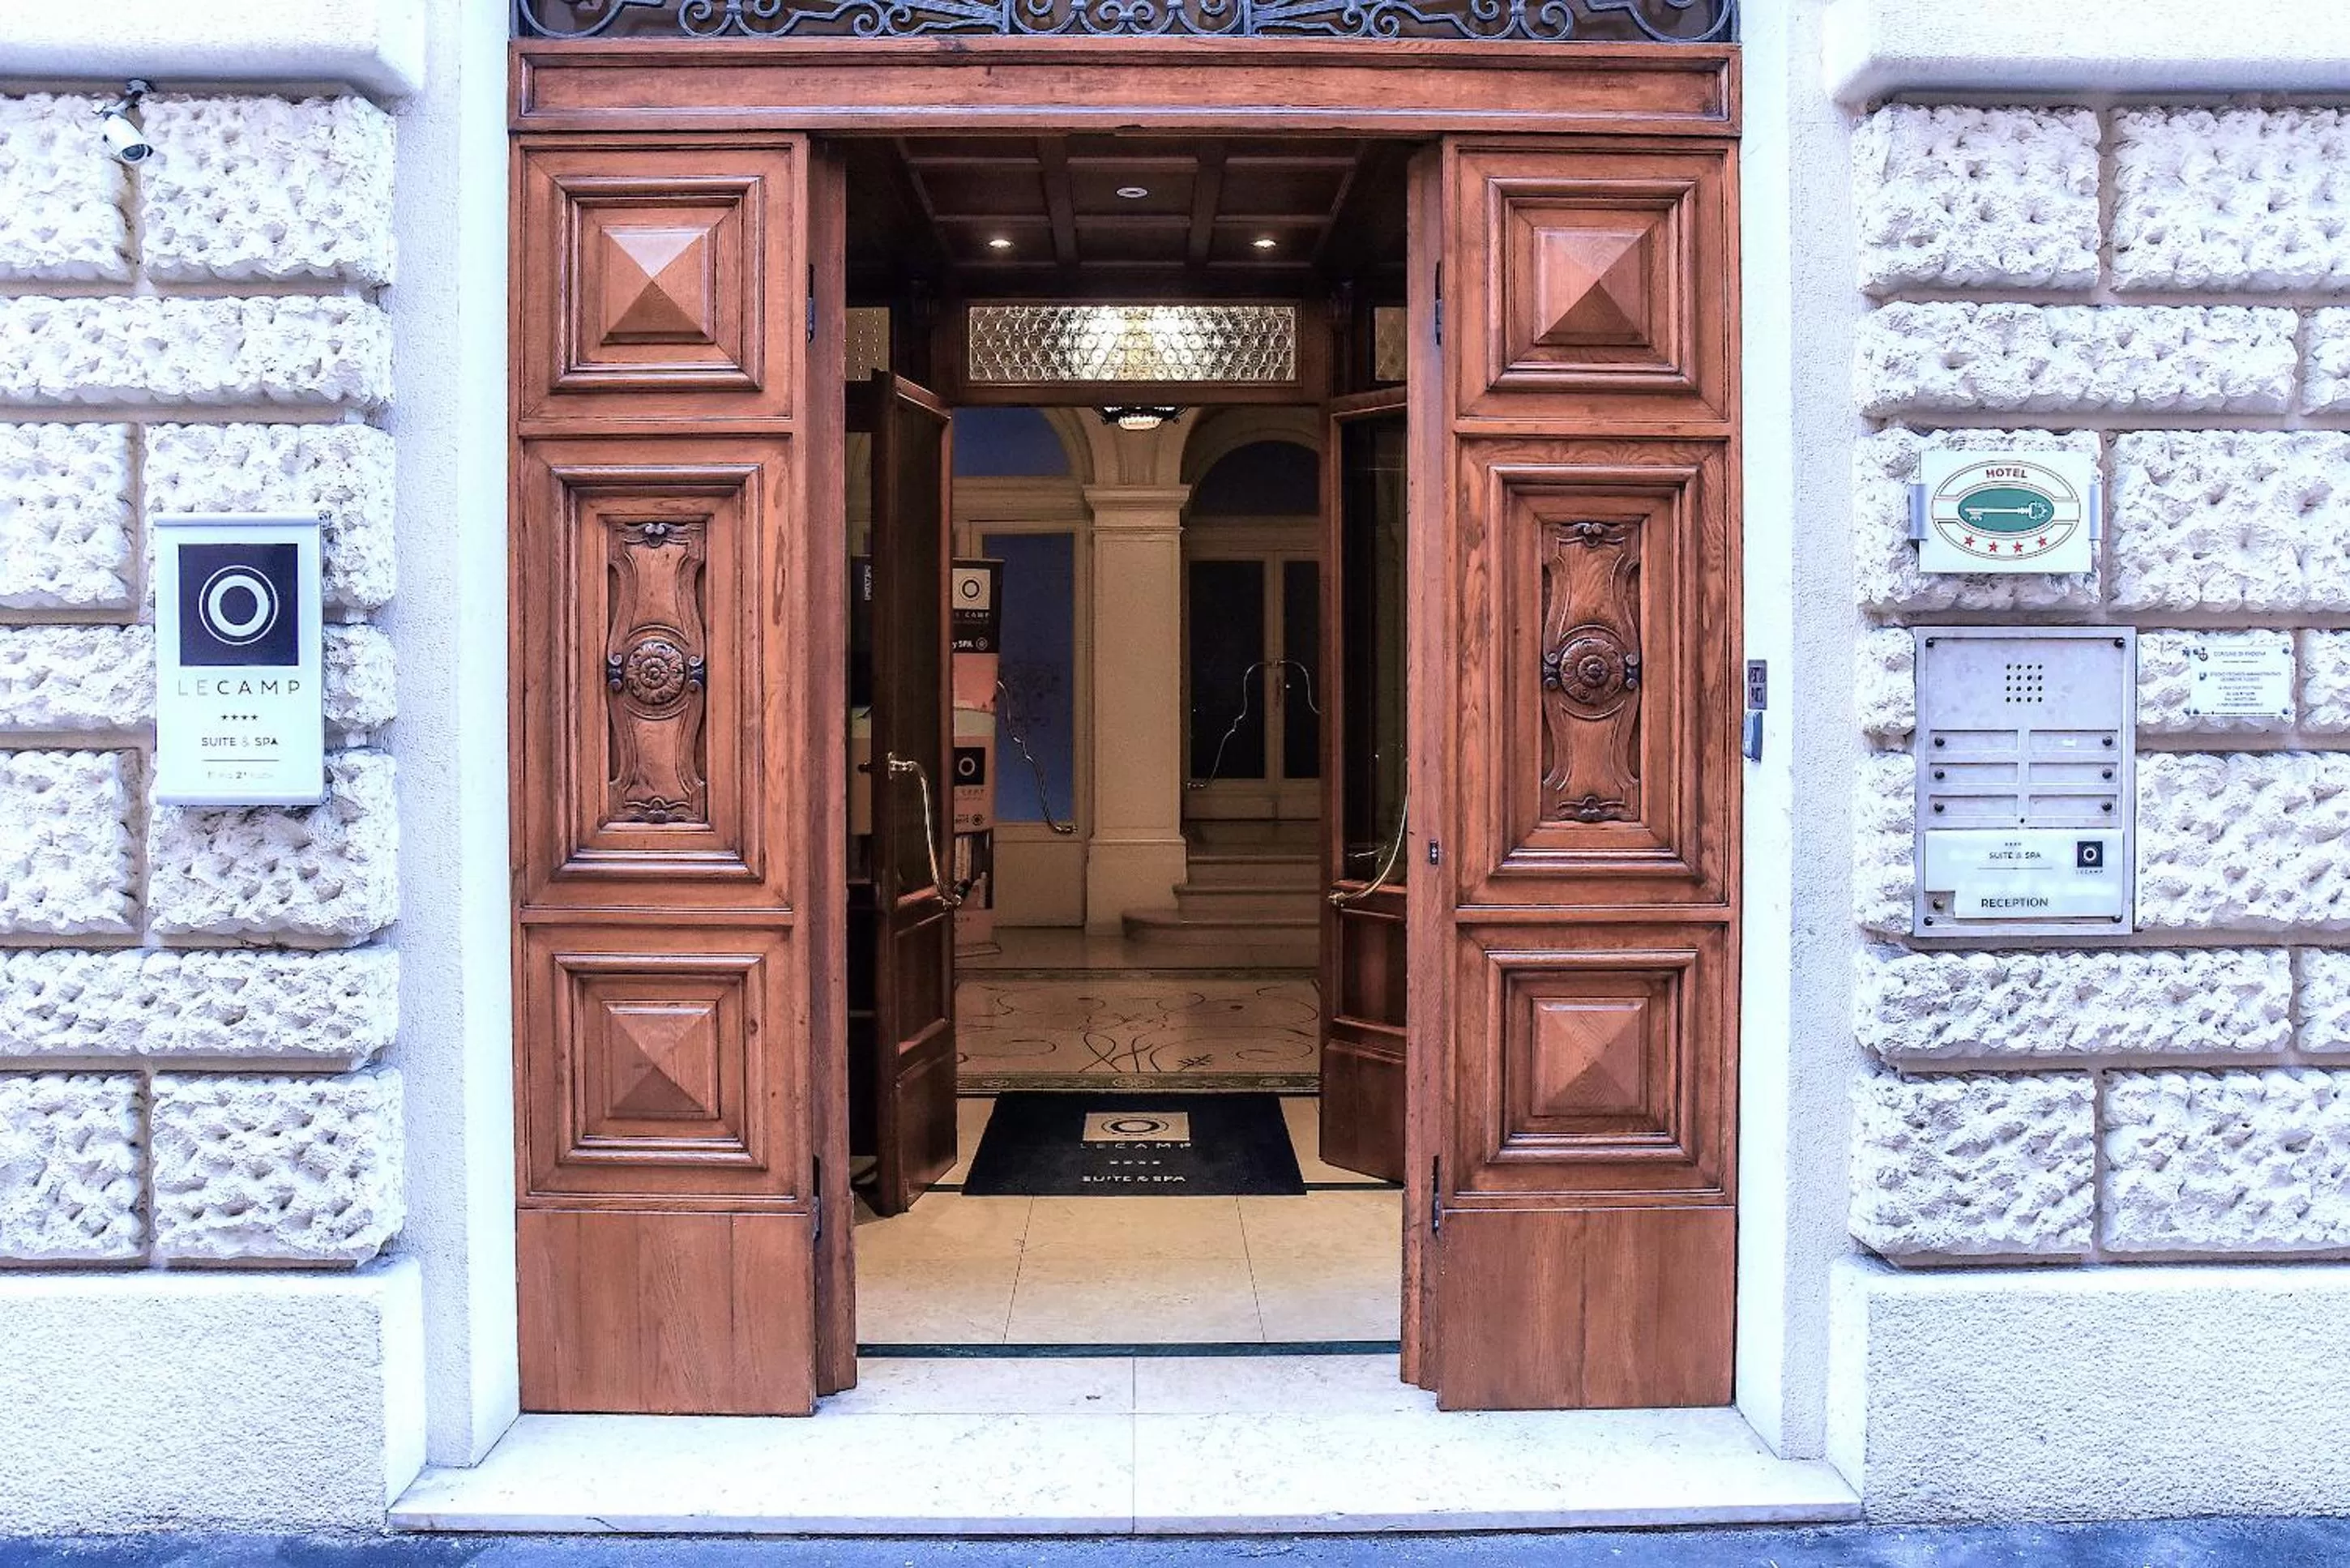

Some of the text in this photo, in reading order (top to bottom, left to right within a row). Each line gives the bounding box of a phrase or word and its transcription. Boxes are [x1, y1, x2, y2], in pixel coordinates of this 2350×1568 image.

[1985, 468, 2028, 479] HOTEL
[177, 679, 301, 696] LECAMP
[202, 737, 237, 746] SUITE
[254, 737, 279, 746] SPA
[1980, 897, 2049, 908] RECEPTION
